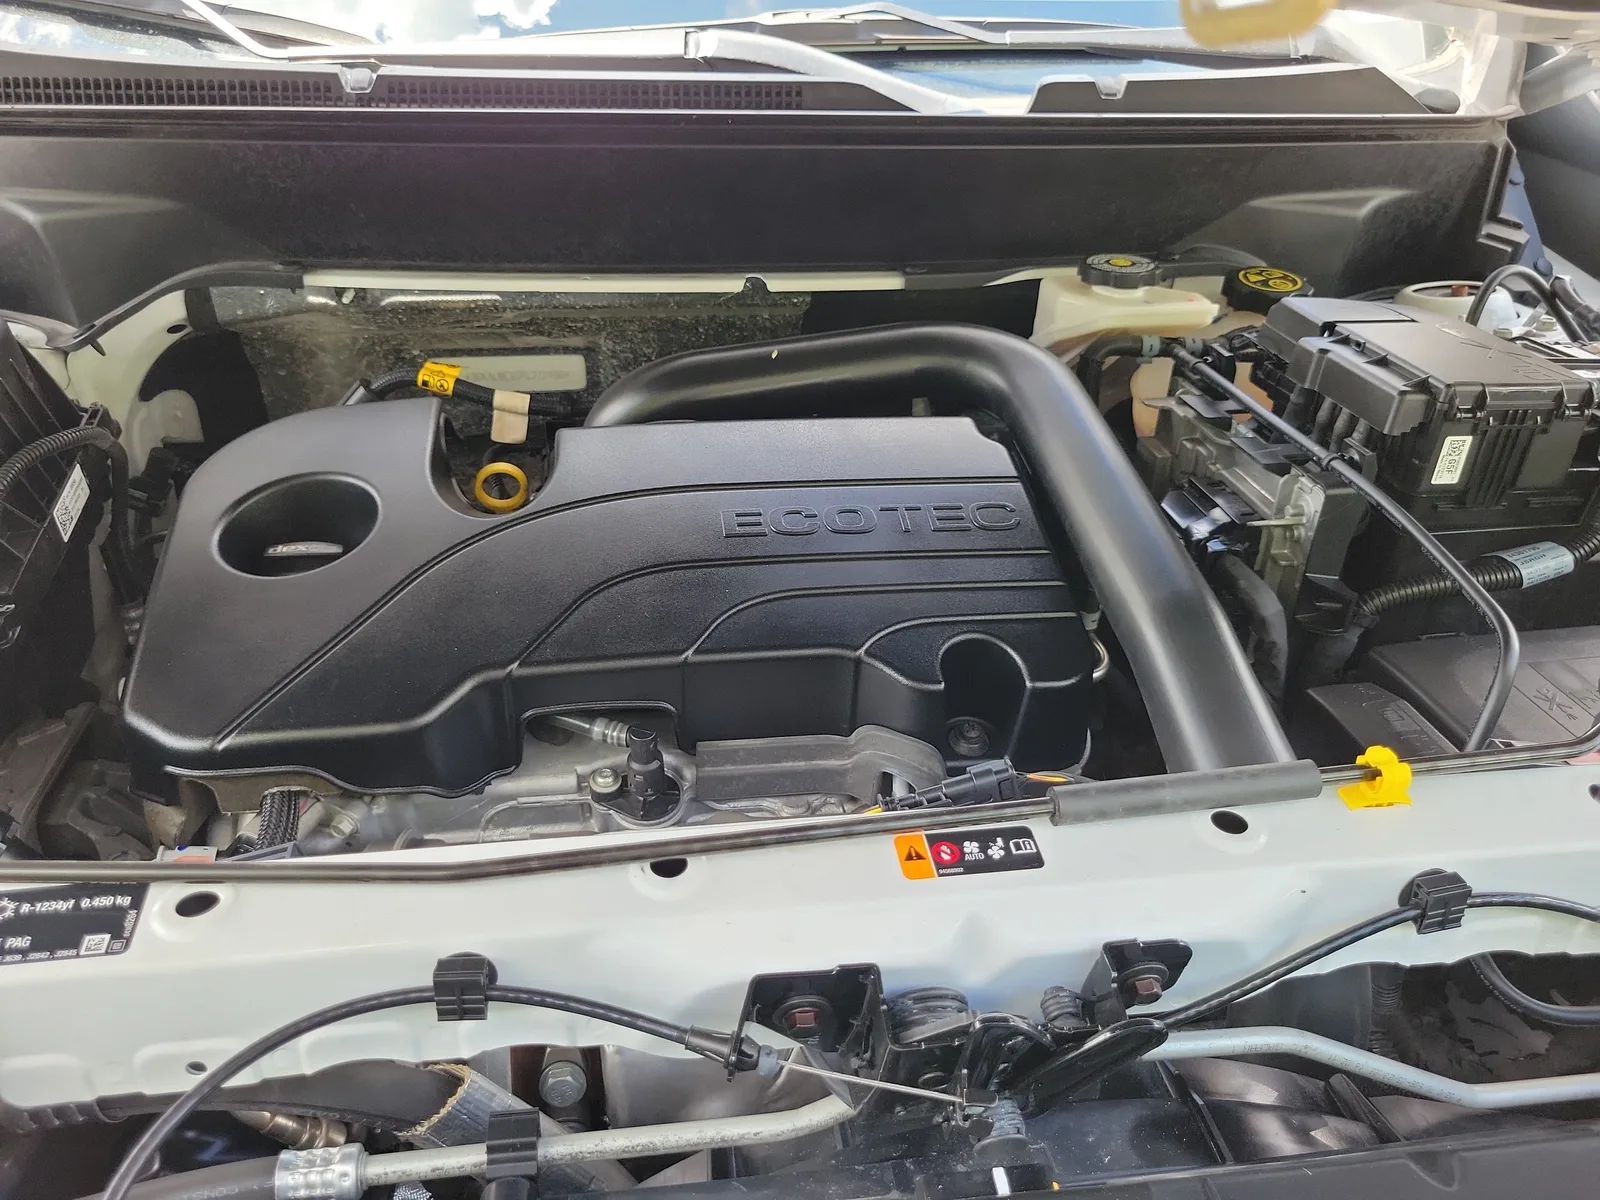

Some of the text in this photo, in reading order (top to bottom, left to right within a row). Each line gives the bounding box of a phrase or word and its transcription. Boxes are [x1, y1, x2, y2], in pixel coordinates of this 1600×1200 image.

[721, 501, 1021, 538] ECOTEC
[964, 852, 985, 861] AUTO
[20, 895, 132, 913] R-1234yf 0.450 kg
[4, 936, 32, 949] PAG
